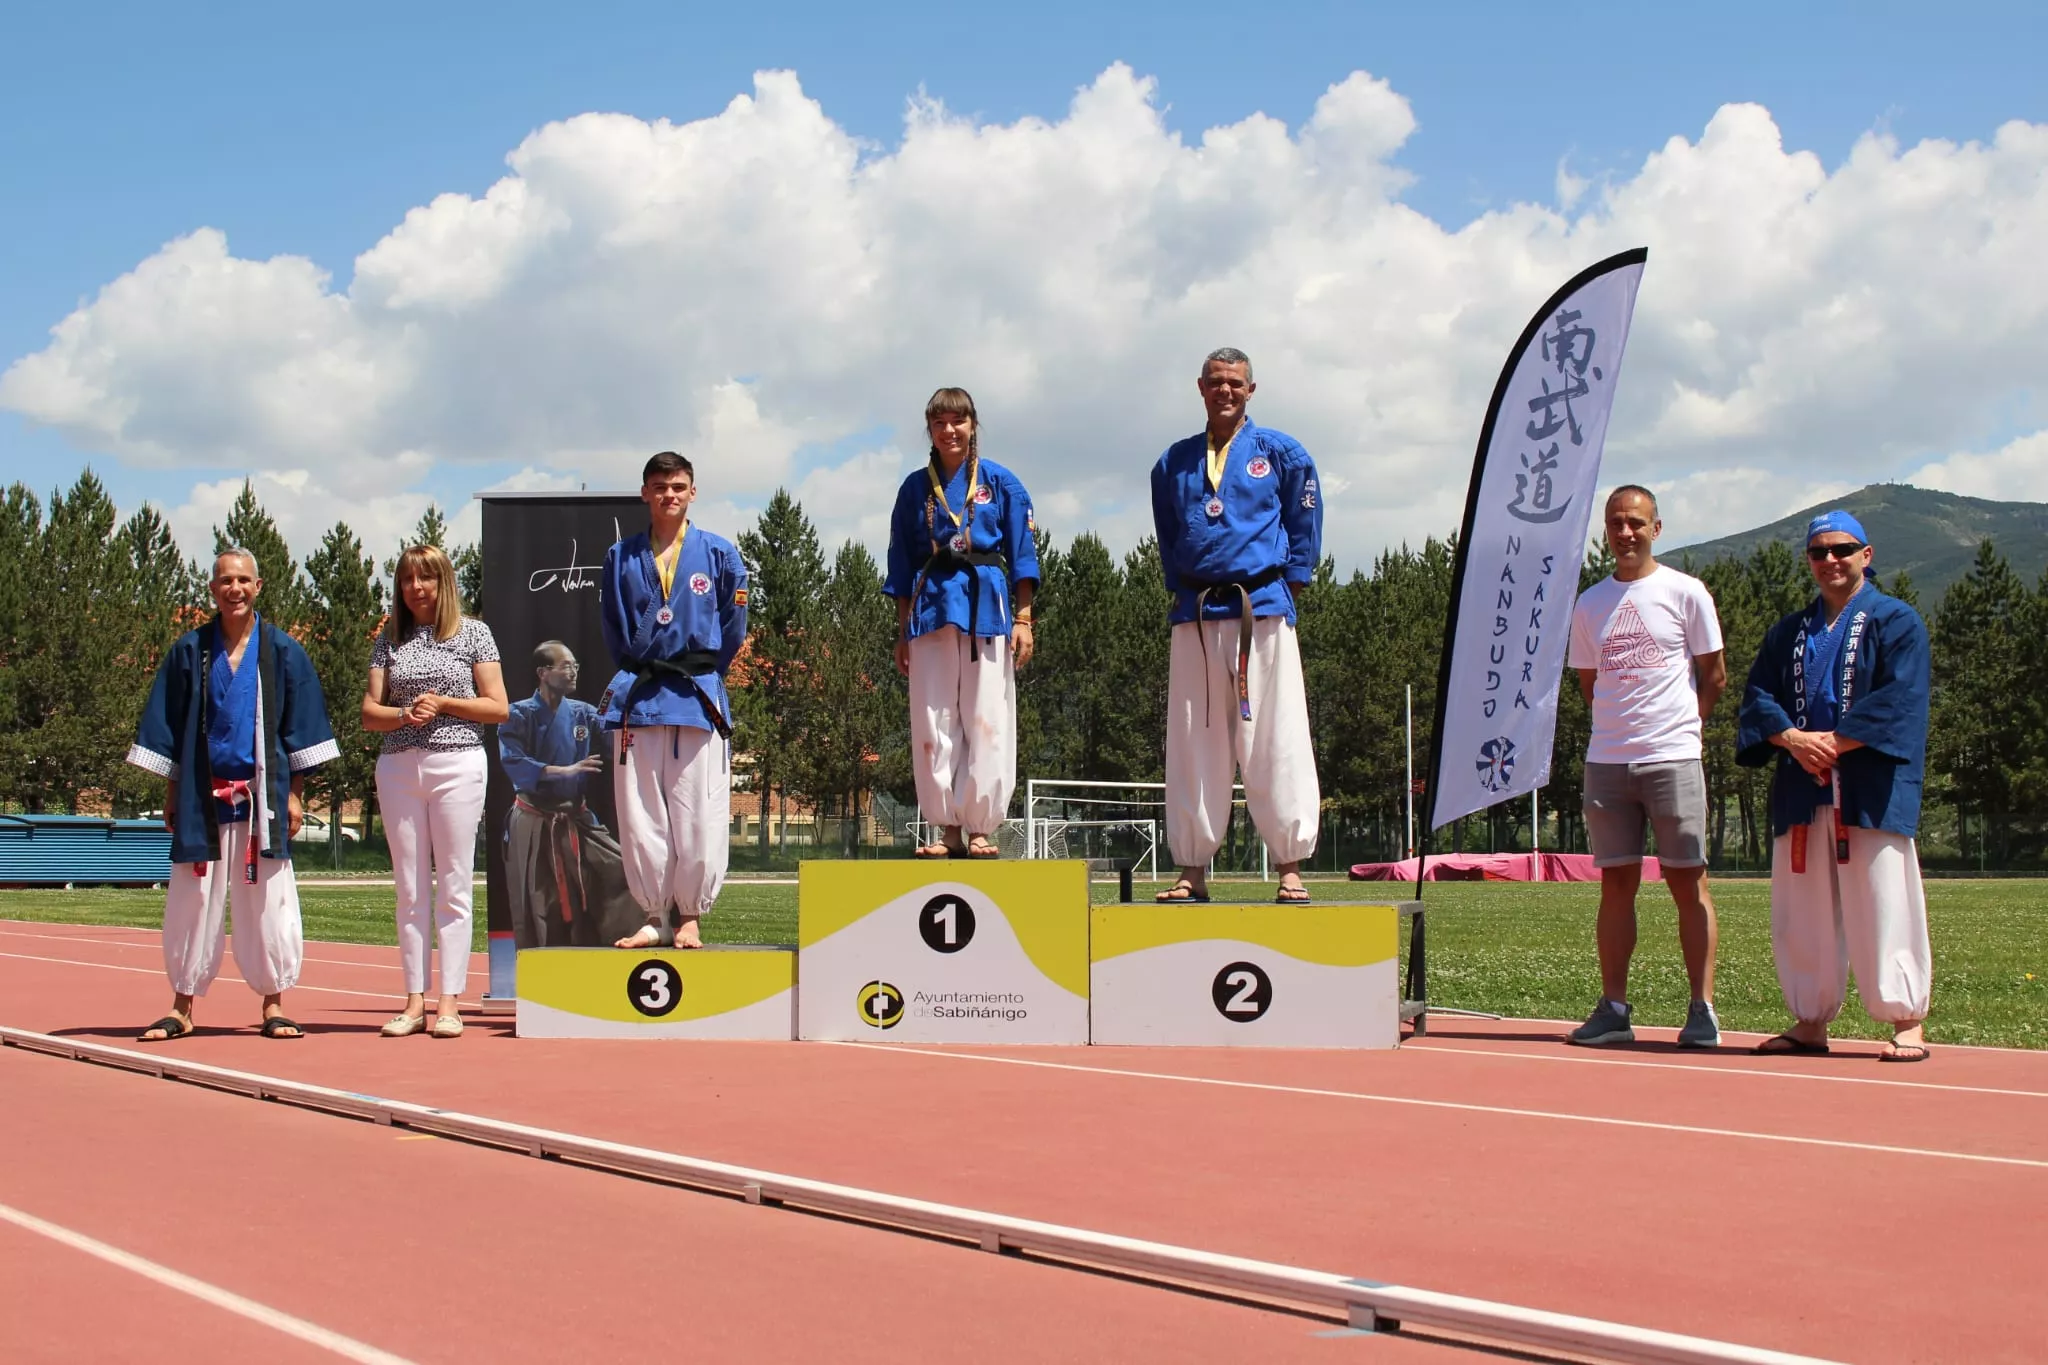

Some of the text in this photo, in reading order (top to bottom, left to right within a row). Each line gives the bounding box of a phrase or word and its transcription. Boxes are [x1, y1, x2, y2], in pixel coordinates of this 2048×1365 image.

[1482, 535, 1521, 719] NANBUDO
[1514, 555, 1554, 710] SAKURA
[1793, 617, 1812, 729] NANBUDO
[932, 902, 959, 946] 1
[639, 967, 671, 1009] 3
[913, 991, 1024, 1005] Ayuntamiento
[1226, 970, 1259, 1014] 2
